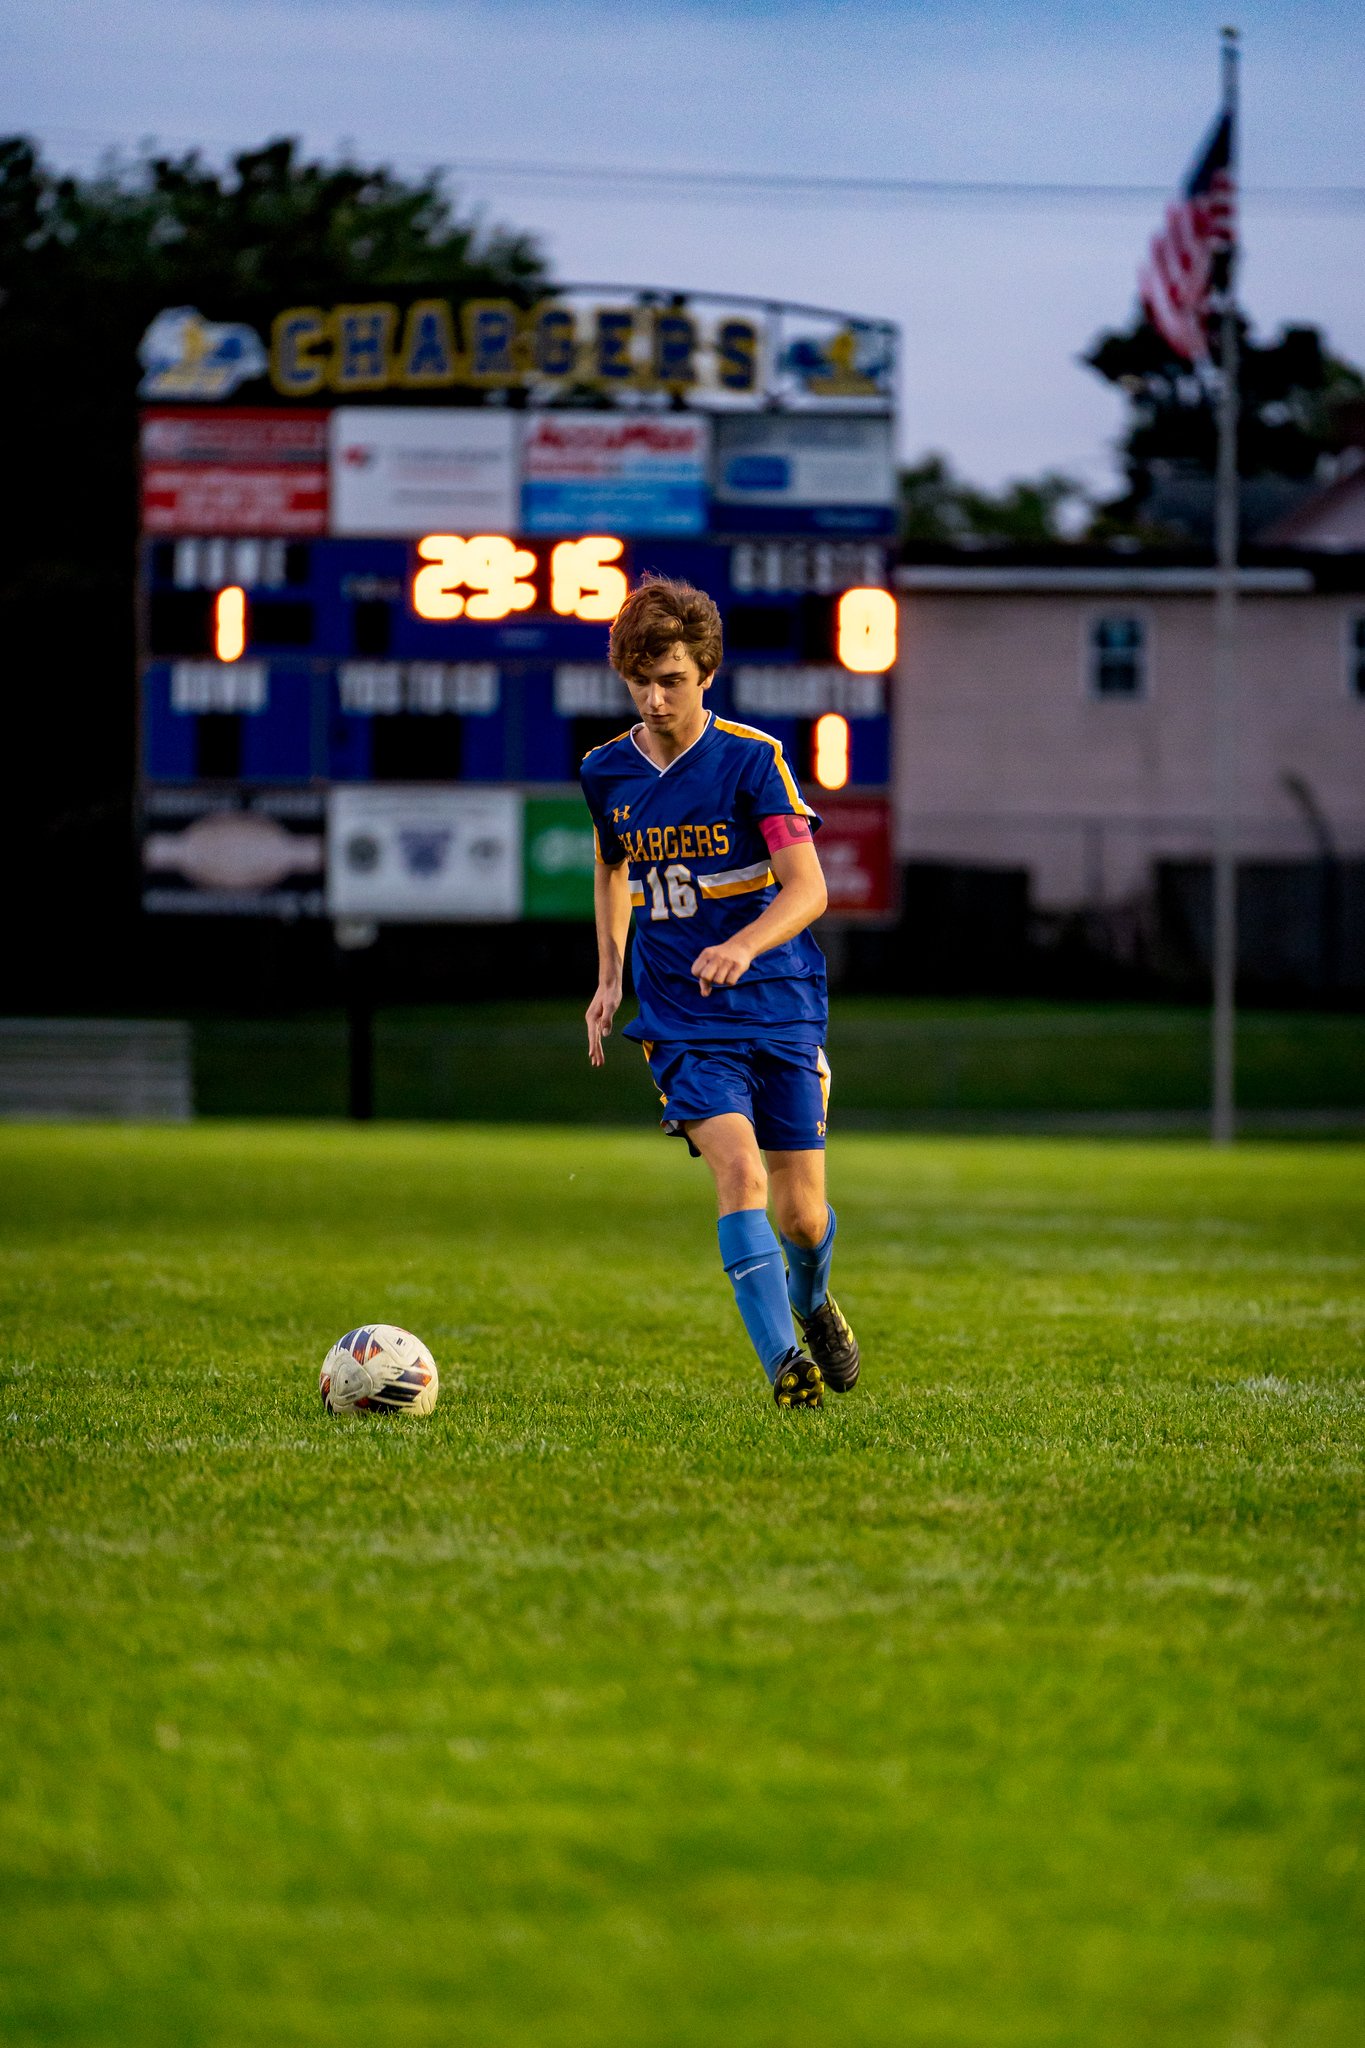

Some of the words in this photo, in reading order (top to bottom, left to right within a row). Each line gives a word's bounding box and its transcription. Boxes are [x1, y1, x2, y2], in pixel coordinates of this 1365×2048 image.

[270, 297, 760, 398] CHARGERS
[618, 823, 730, 863] HARGERS
[646, 863, 699, 922] 16
